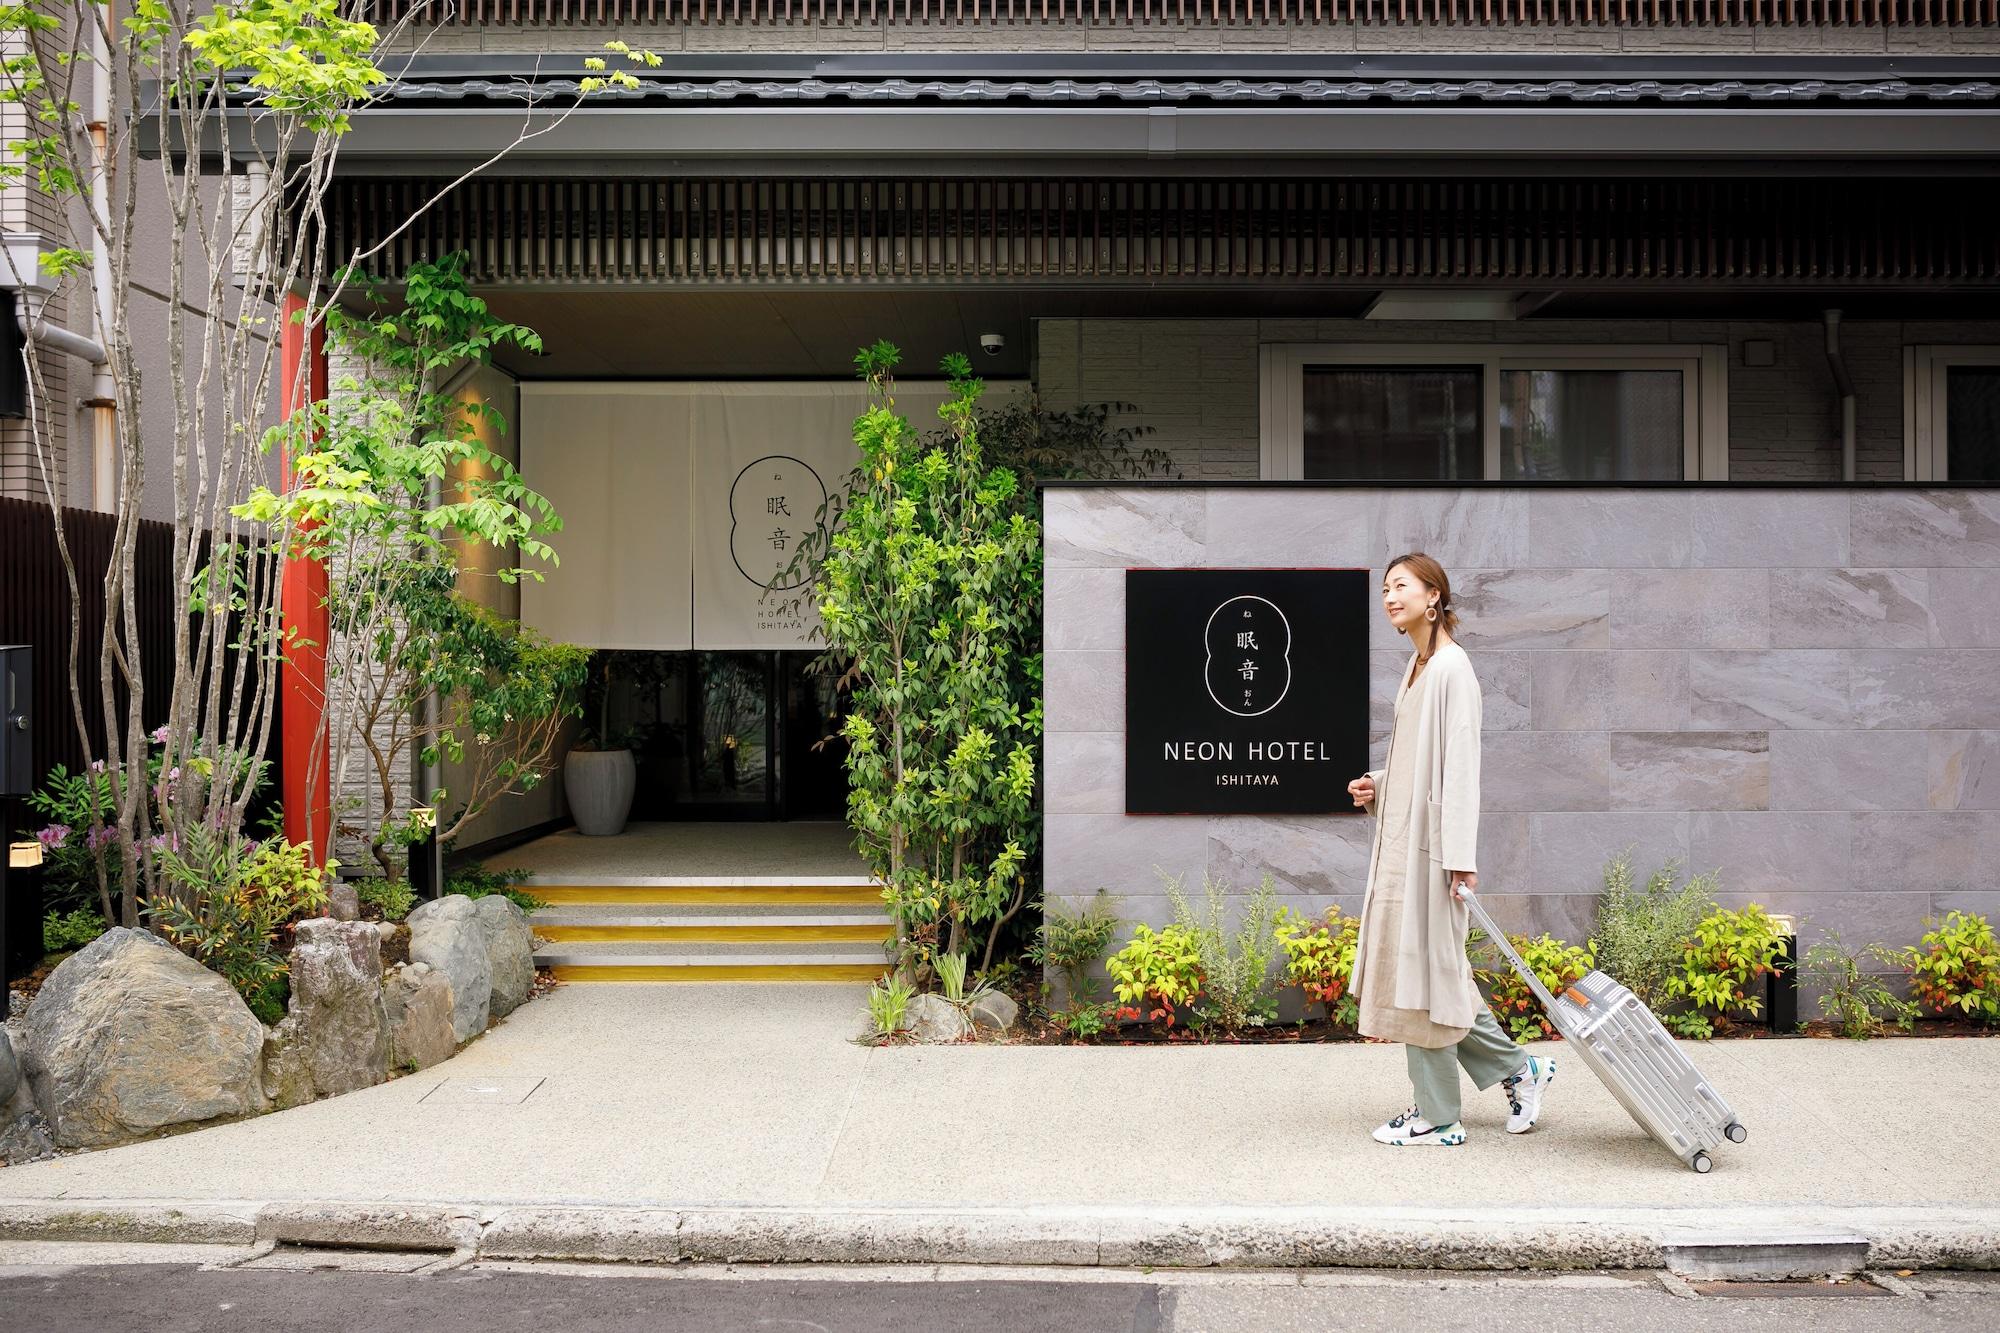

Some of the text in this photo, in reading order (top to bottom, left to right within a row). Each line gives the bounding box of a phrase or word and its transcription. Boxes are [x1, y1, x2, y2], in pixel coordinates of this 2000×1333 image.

[767, 496, 791, 551] 眠音
[757, 622, 802, 630] ISHITAYA
[1237, 610, 1259, 707] ね 眠音 おん
[1164, 741, 1331, 761] NEON HOTEL
[1216, 774, 1280, 786] ISHITAYA
